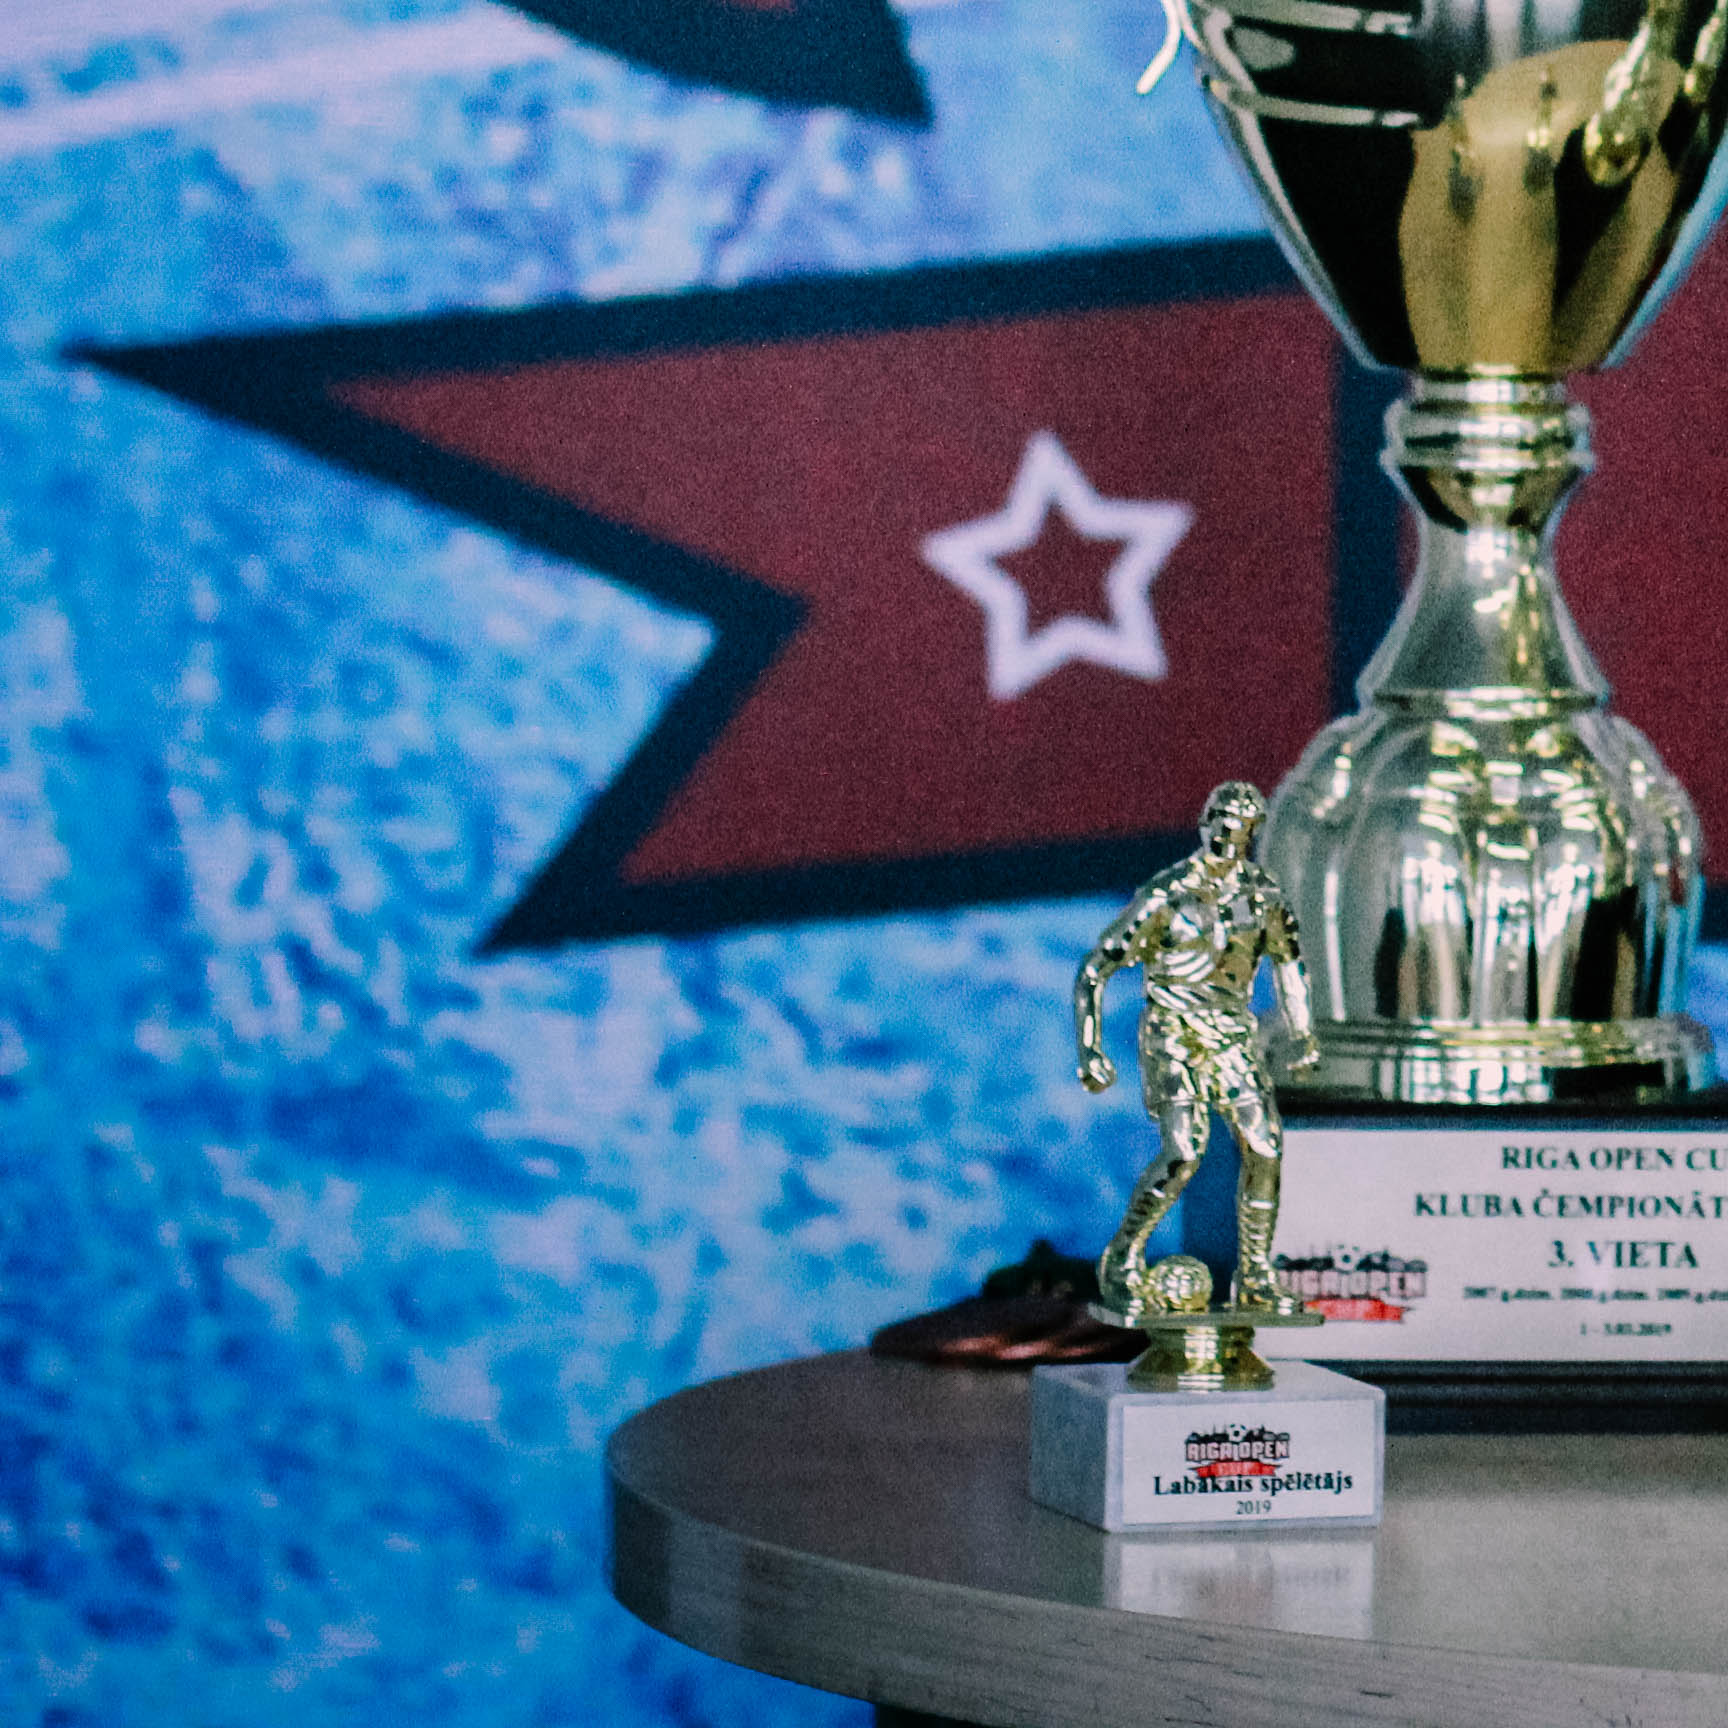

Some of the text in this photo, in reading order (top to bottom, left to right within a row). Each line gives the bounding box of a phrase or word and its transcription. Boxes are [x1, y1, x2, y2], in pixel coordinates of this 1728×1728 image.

[1502, 1146, 1580, 1171] RIGA
[1589, 1147, 1673, 1171] OPEN
[1415, 1194, 1523, 1217] KLUBA
[1549, 1239, 1698, 1269] 3. VIETA
[1153, 1470, 1353, 1497] Labākais spēlētājs
[1235, 1499, 1272, 1516] 2019
